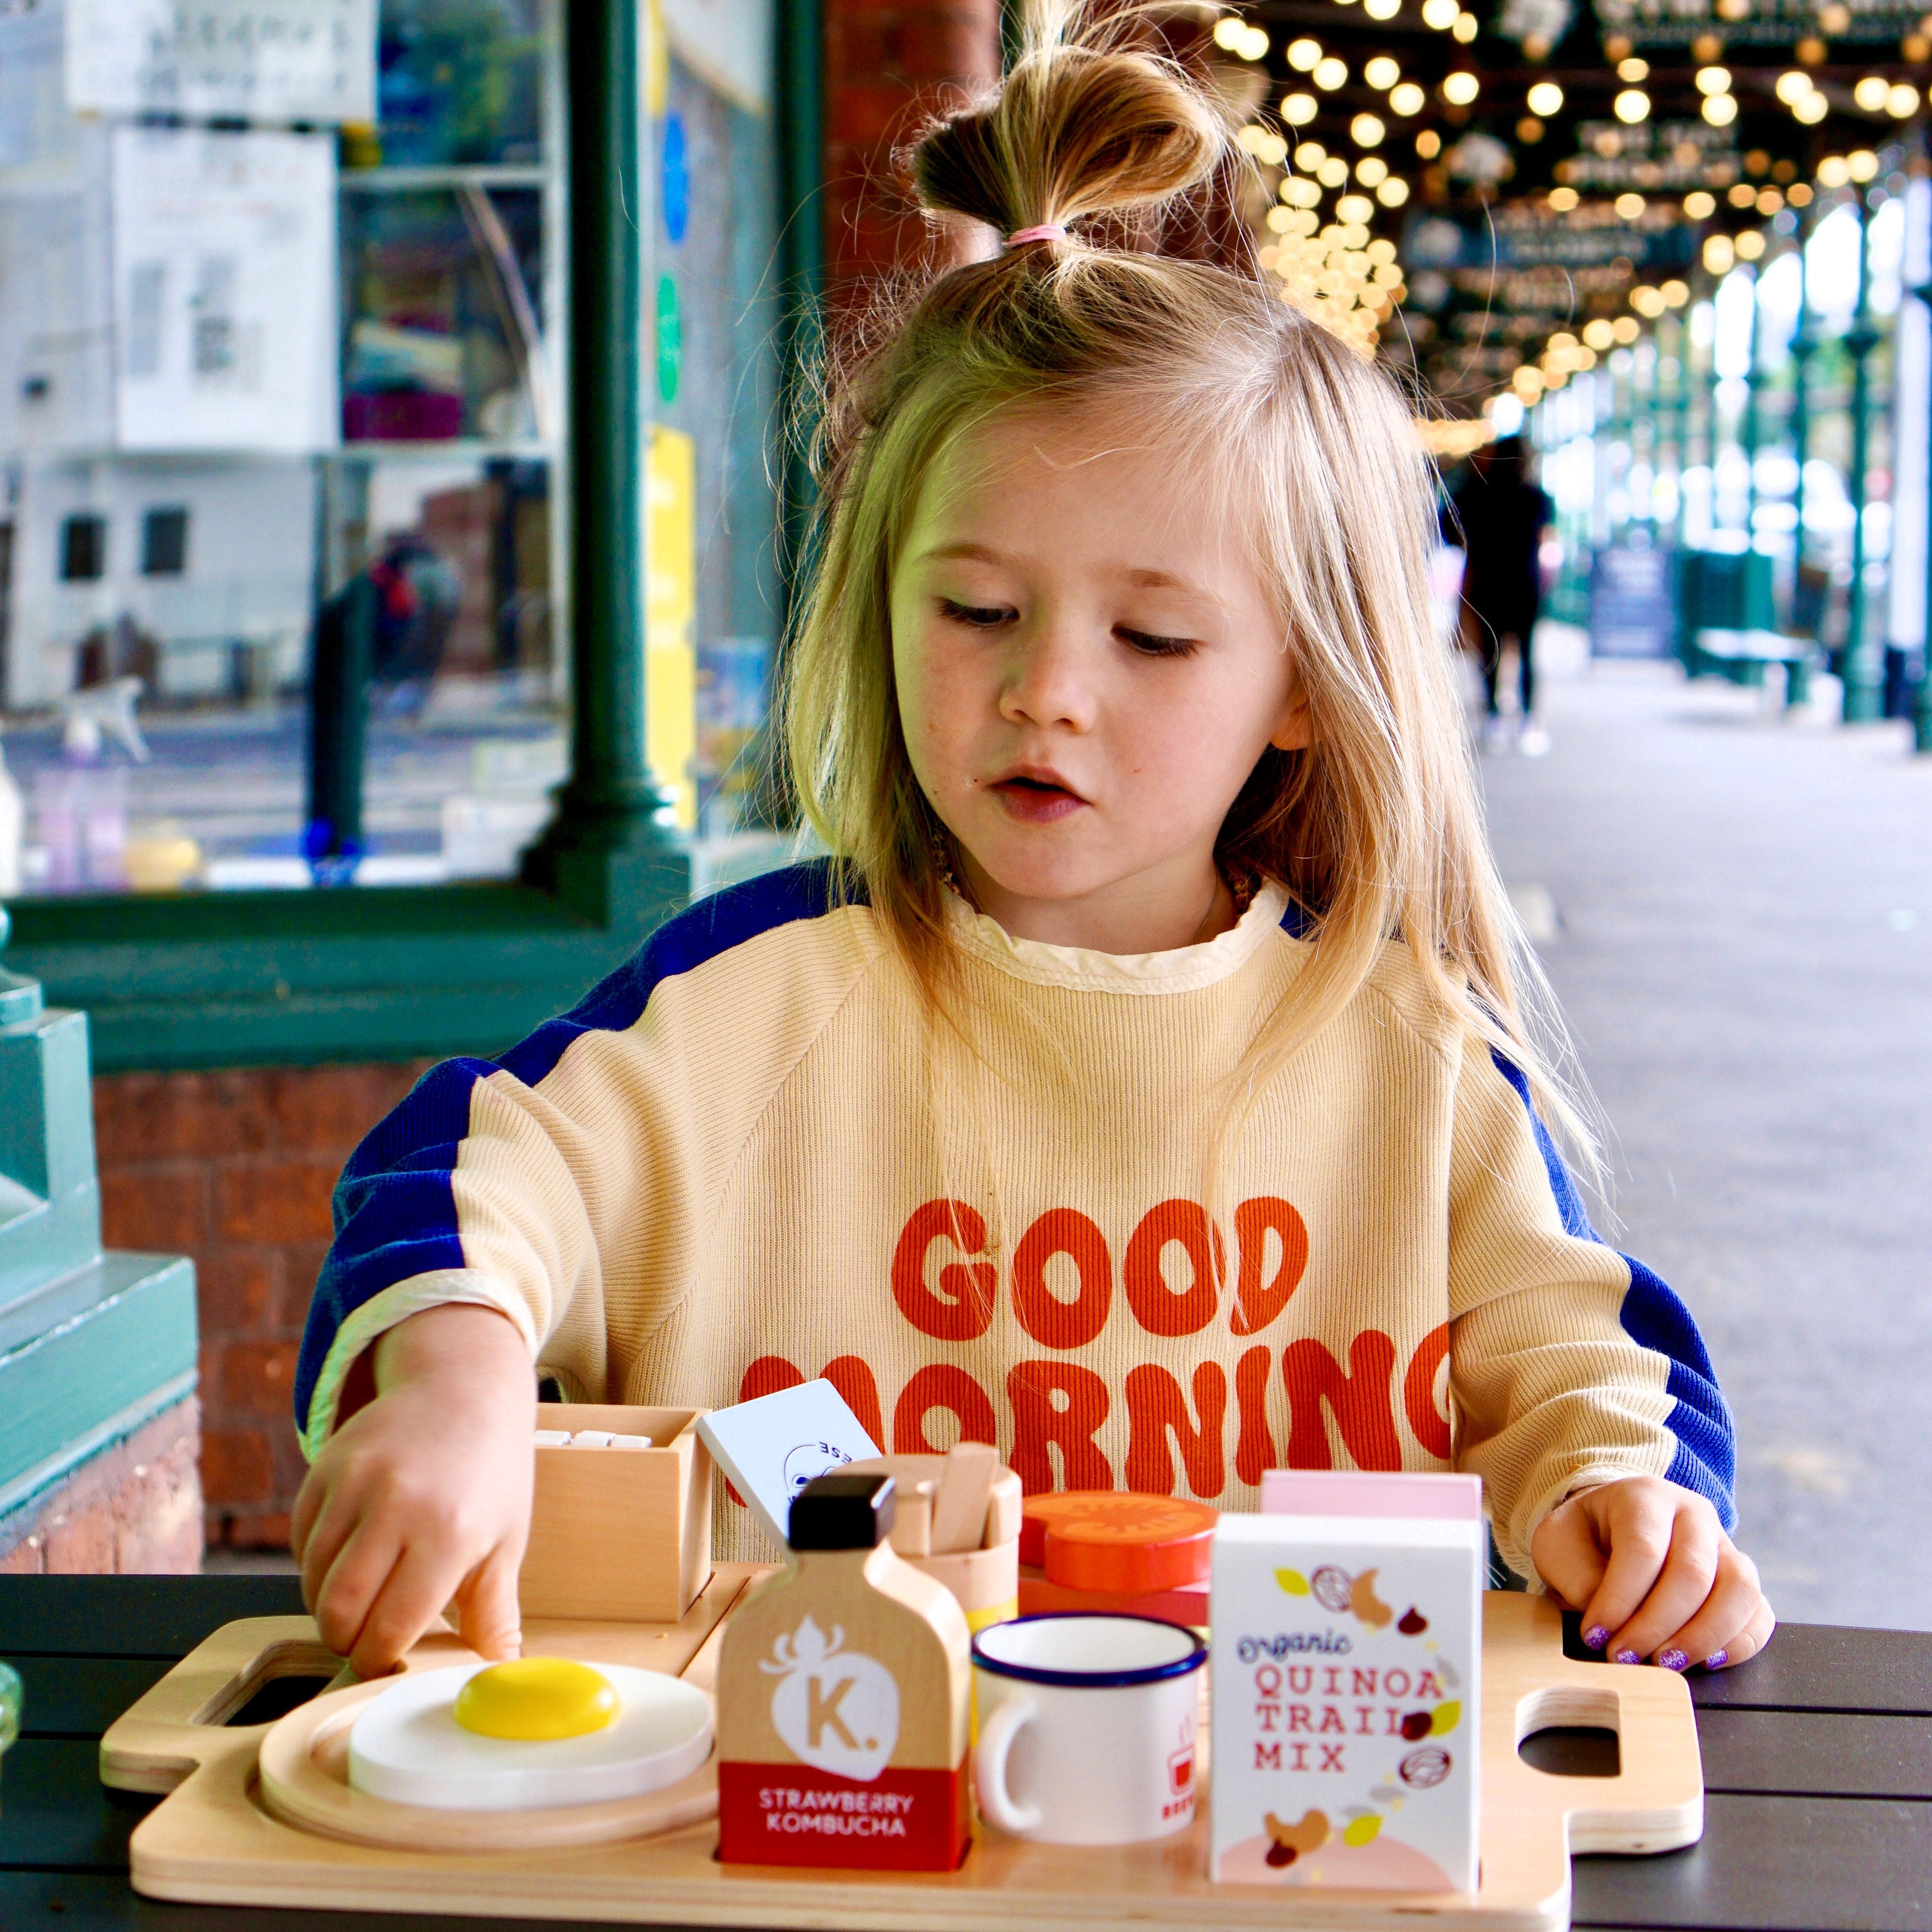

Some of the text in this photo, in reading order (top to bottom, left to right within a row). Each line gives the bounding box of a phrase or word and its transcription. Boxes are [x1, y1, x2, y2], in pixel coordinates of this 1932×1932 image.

[892, 1196, 1308, 1350] GOOD
[1255, 1663, 1443, 1699] QUINOA
[808, 1675, 878, 1750] K.
[1254, 1741, 1346, 1773] MIX
[759, 1787, 914, 1815] STRAWBERRY
[767, 1812, 907, 1837] KOMBUCHA
